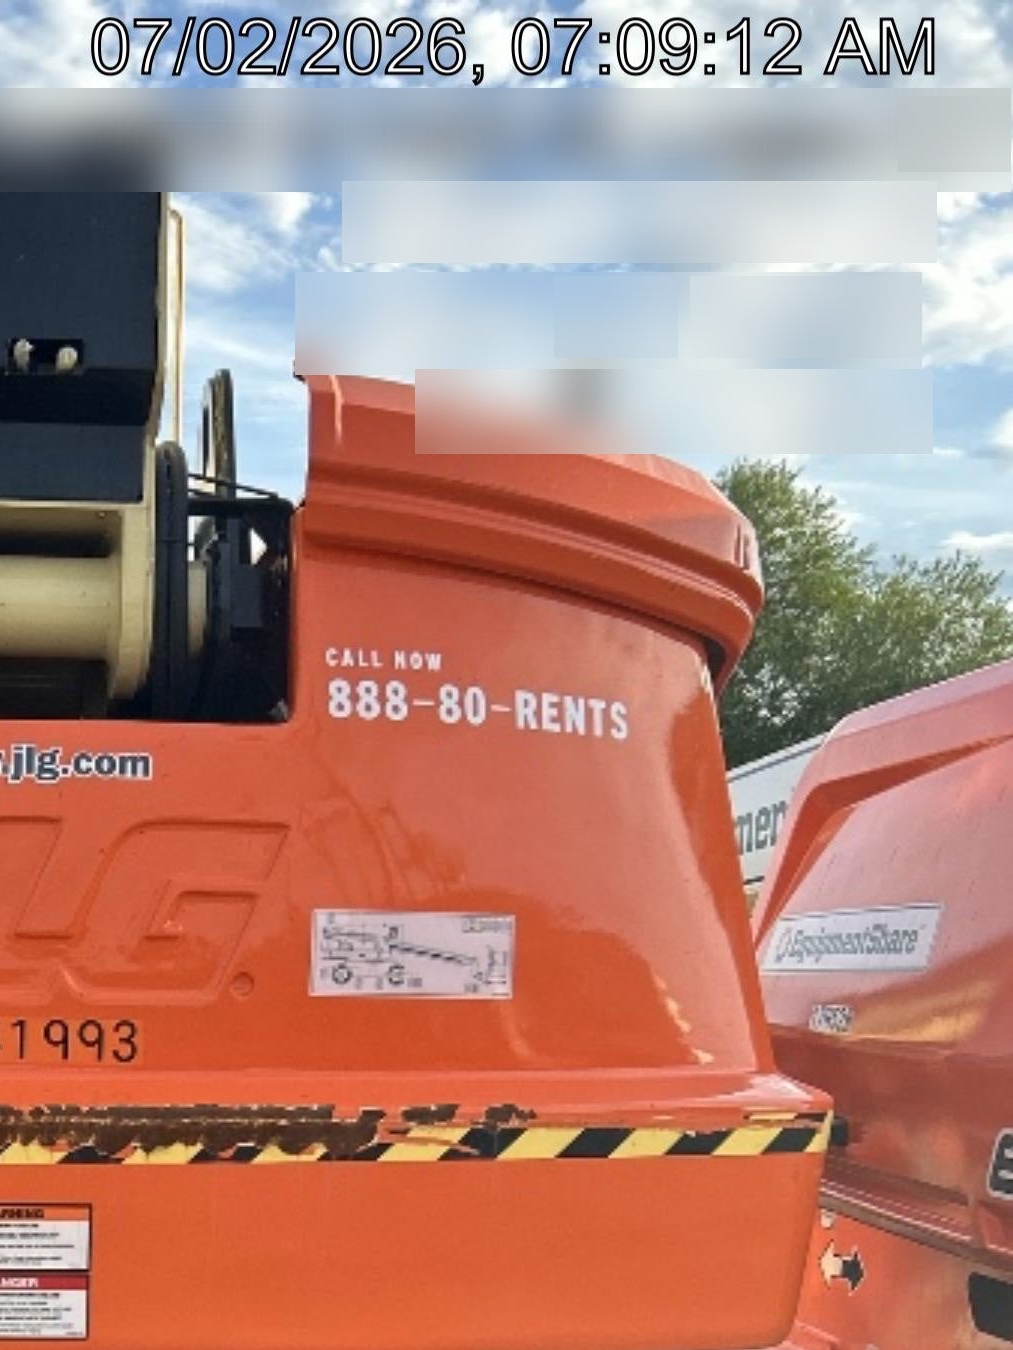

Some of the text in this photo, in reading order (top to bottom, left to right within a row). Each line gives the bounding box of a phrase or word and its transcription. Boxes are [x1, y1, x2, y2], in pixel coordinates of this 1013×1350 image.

[324, 647, 442, 671] CALL NOW
[327, 677, 629, 741] 888-80-RENTS
